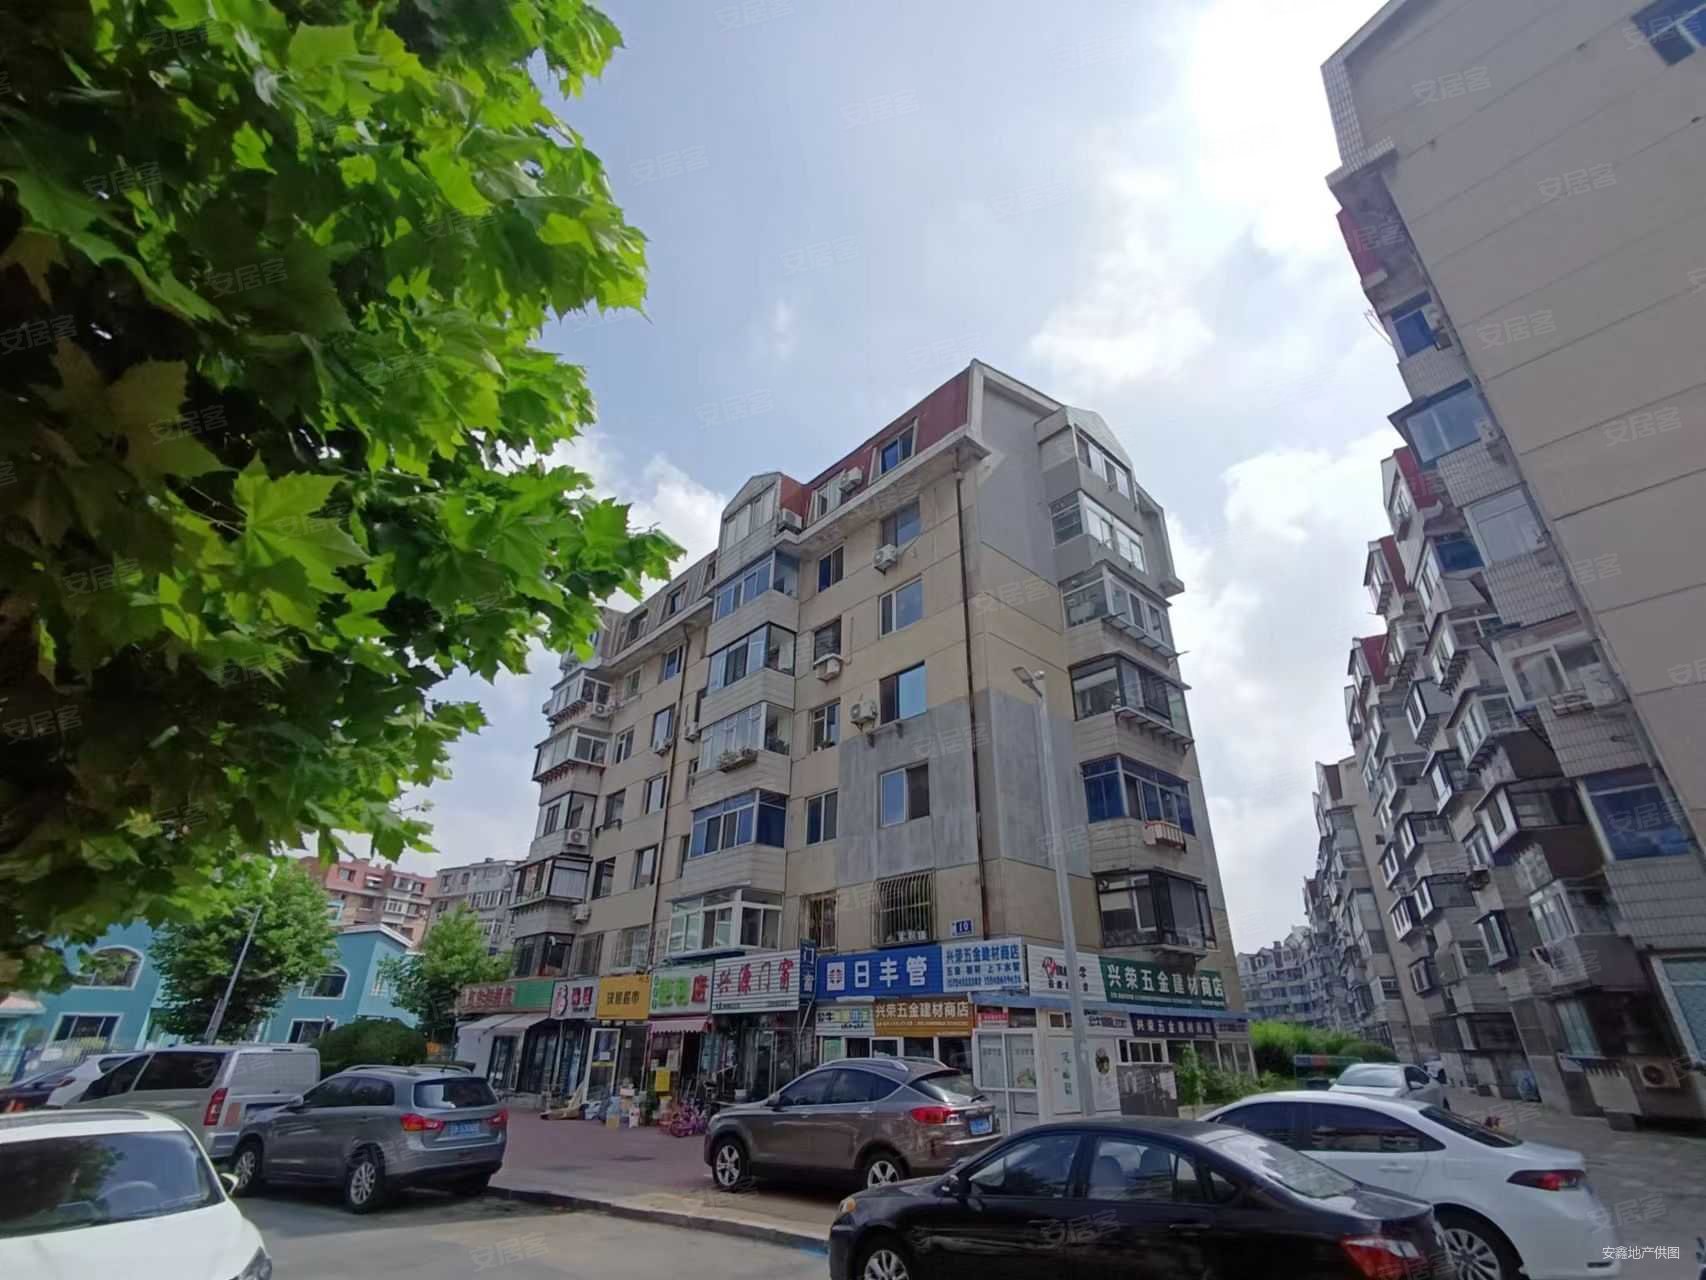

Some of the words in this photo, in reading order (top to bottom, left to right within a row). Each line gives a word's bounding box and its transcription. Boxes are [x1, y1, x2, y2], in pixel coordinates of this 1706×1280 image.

[958, 921, 970, 933] 10
[854, 955, 928, 988] 日丰管
[1106, 963, 1225, 998] 兴荣五金建材商店
[875, 1002, 969, 1018] 兴荣五金建材商店
